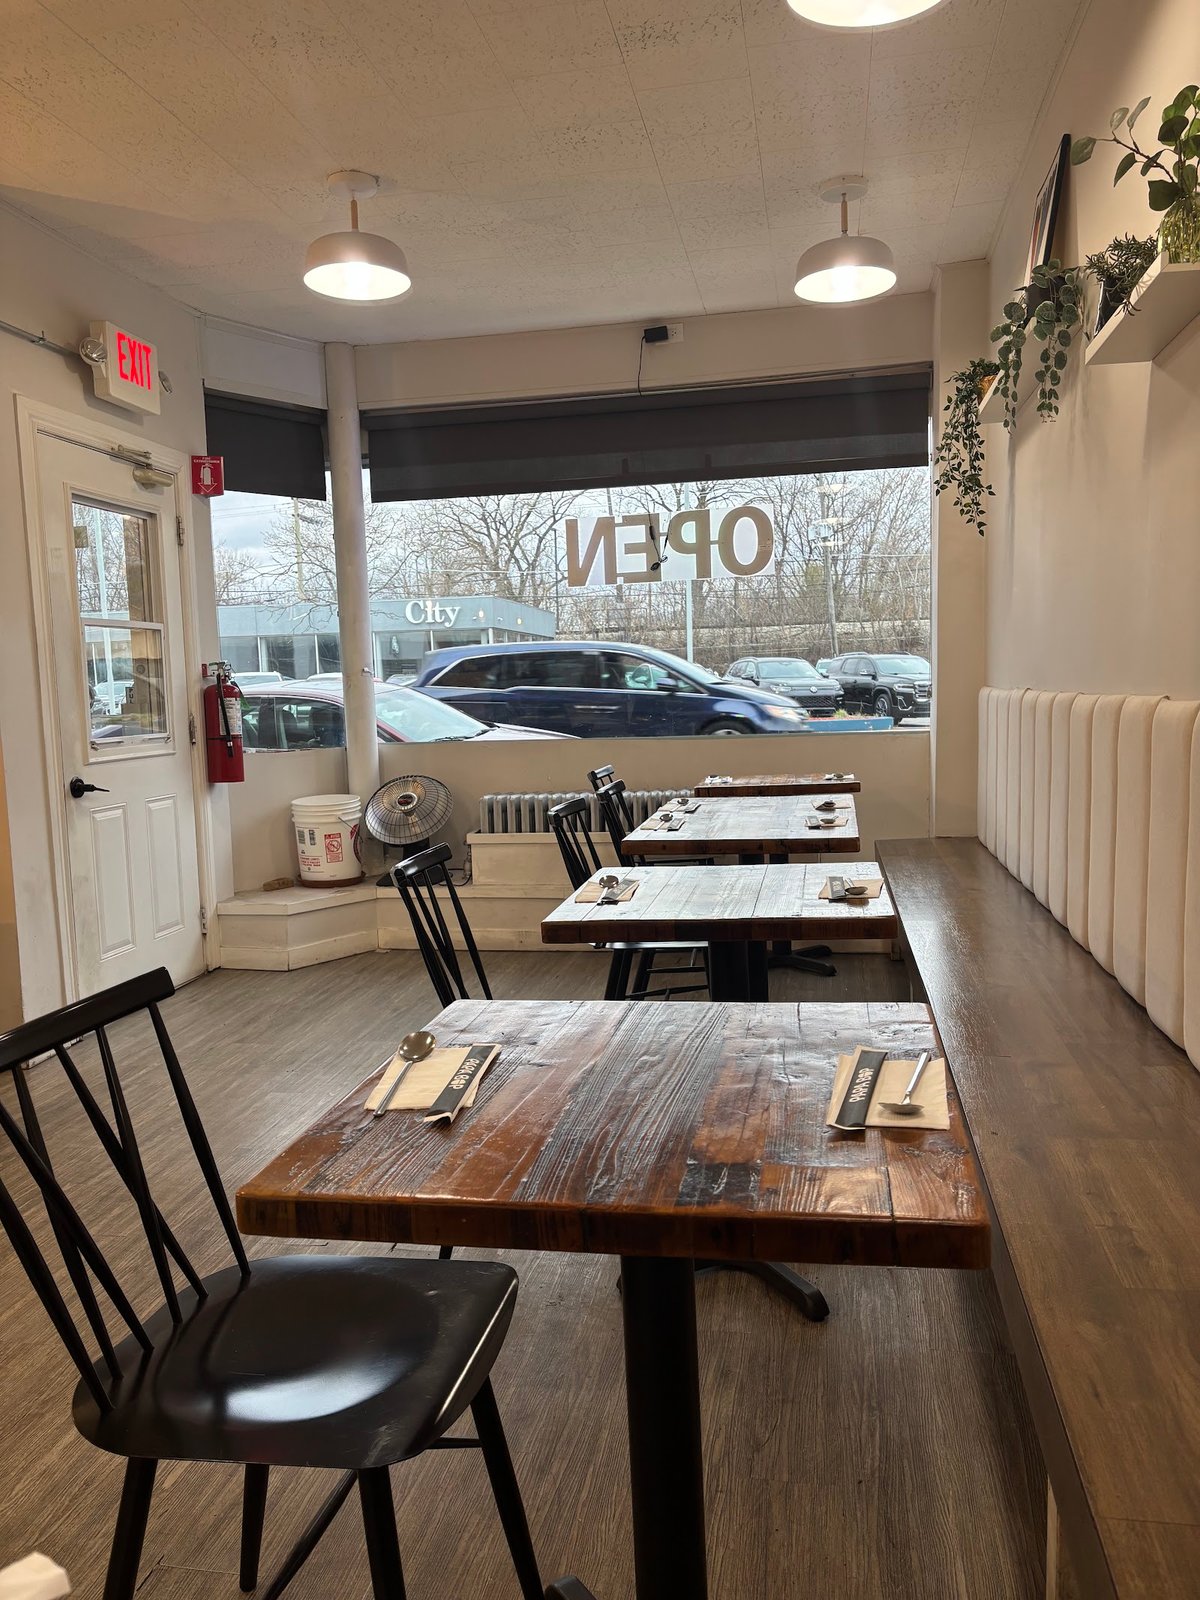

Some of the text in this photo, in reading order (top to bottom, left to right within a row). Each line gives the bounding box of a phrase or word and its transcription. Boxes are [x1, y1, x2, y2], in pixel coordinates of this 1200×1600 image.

[116, 331, 152, 391] EXIT
[405, 600, 461, 628] City
[459, 1058, 479, 1074] PAPA
[848, 1080, 871, 1103] PAPA
